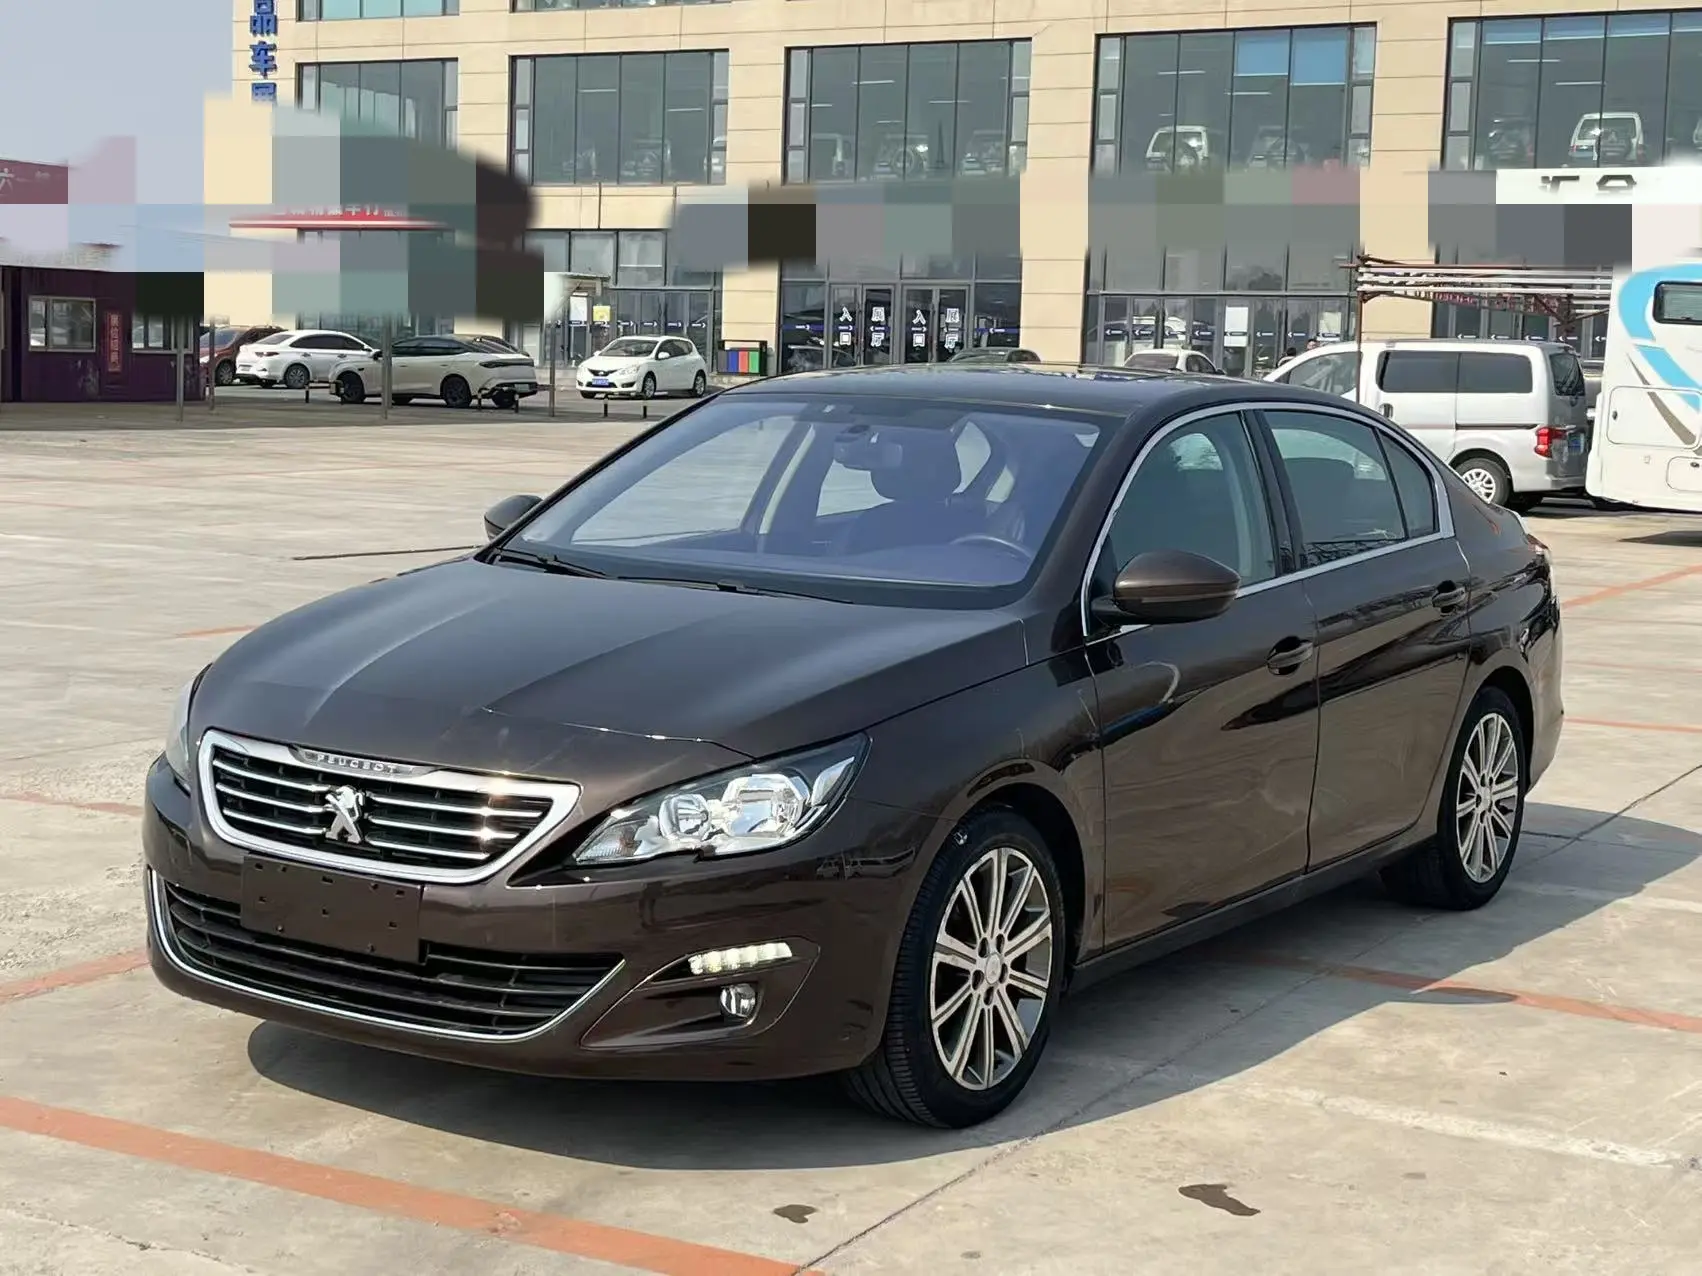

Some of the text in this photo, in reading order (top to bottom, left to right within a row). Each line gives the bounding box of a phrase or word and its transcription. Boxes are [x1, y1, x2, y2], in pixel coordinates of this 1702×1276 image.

[839, 306, 853, 346] 入口
[911, 309, 927, 347] 入口
[317, 754, 398, 775] PEUGEOT
